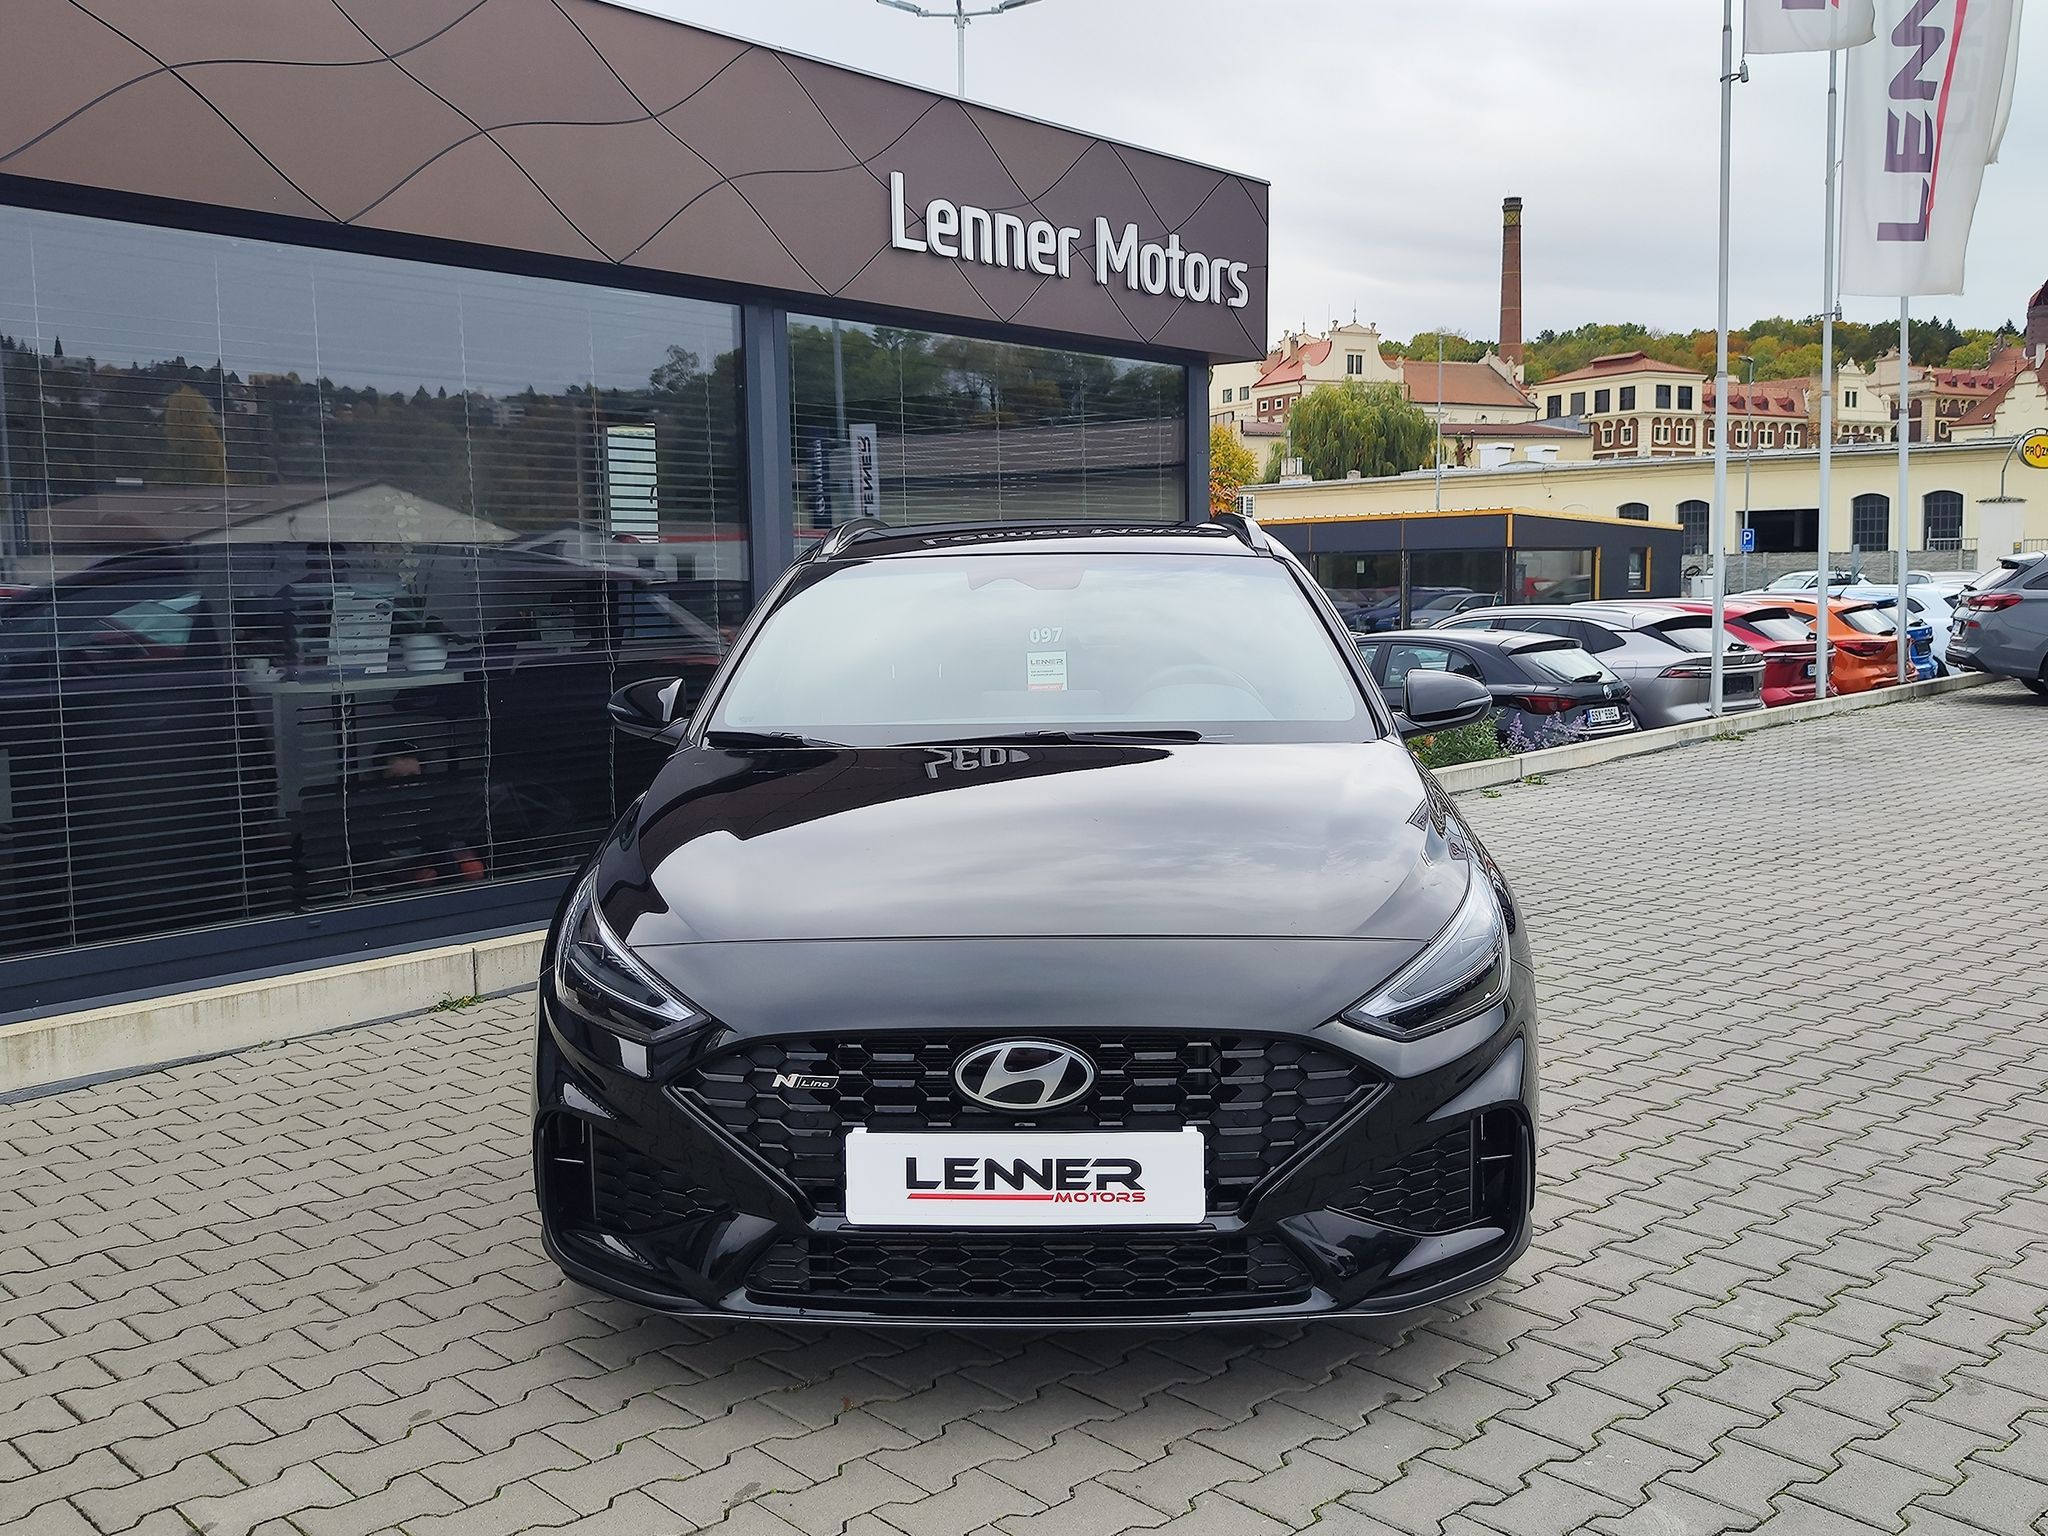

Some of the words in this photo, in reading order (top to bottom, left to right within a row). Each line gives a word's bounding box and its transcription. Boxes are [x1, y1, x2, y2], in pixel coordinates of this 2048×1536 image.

[890, 171, 1081, 278] Lenner
[1095, 216, 1250, 309] Motors
[1743, 531, 1752, 545] P
[1029, 626, 1063, 643] 097
[772, 1073, 798, 1088] N
[906, 1157, 1146, 1190] LENNER
[1054, 1191, 1146, 1203] MOTORS
